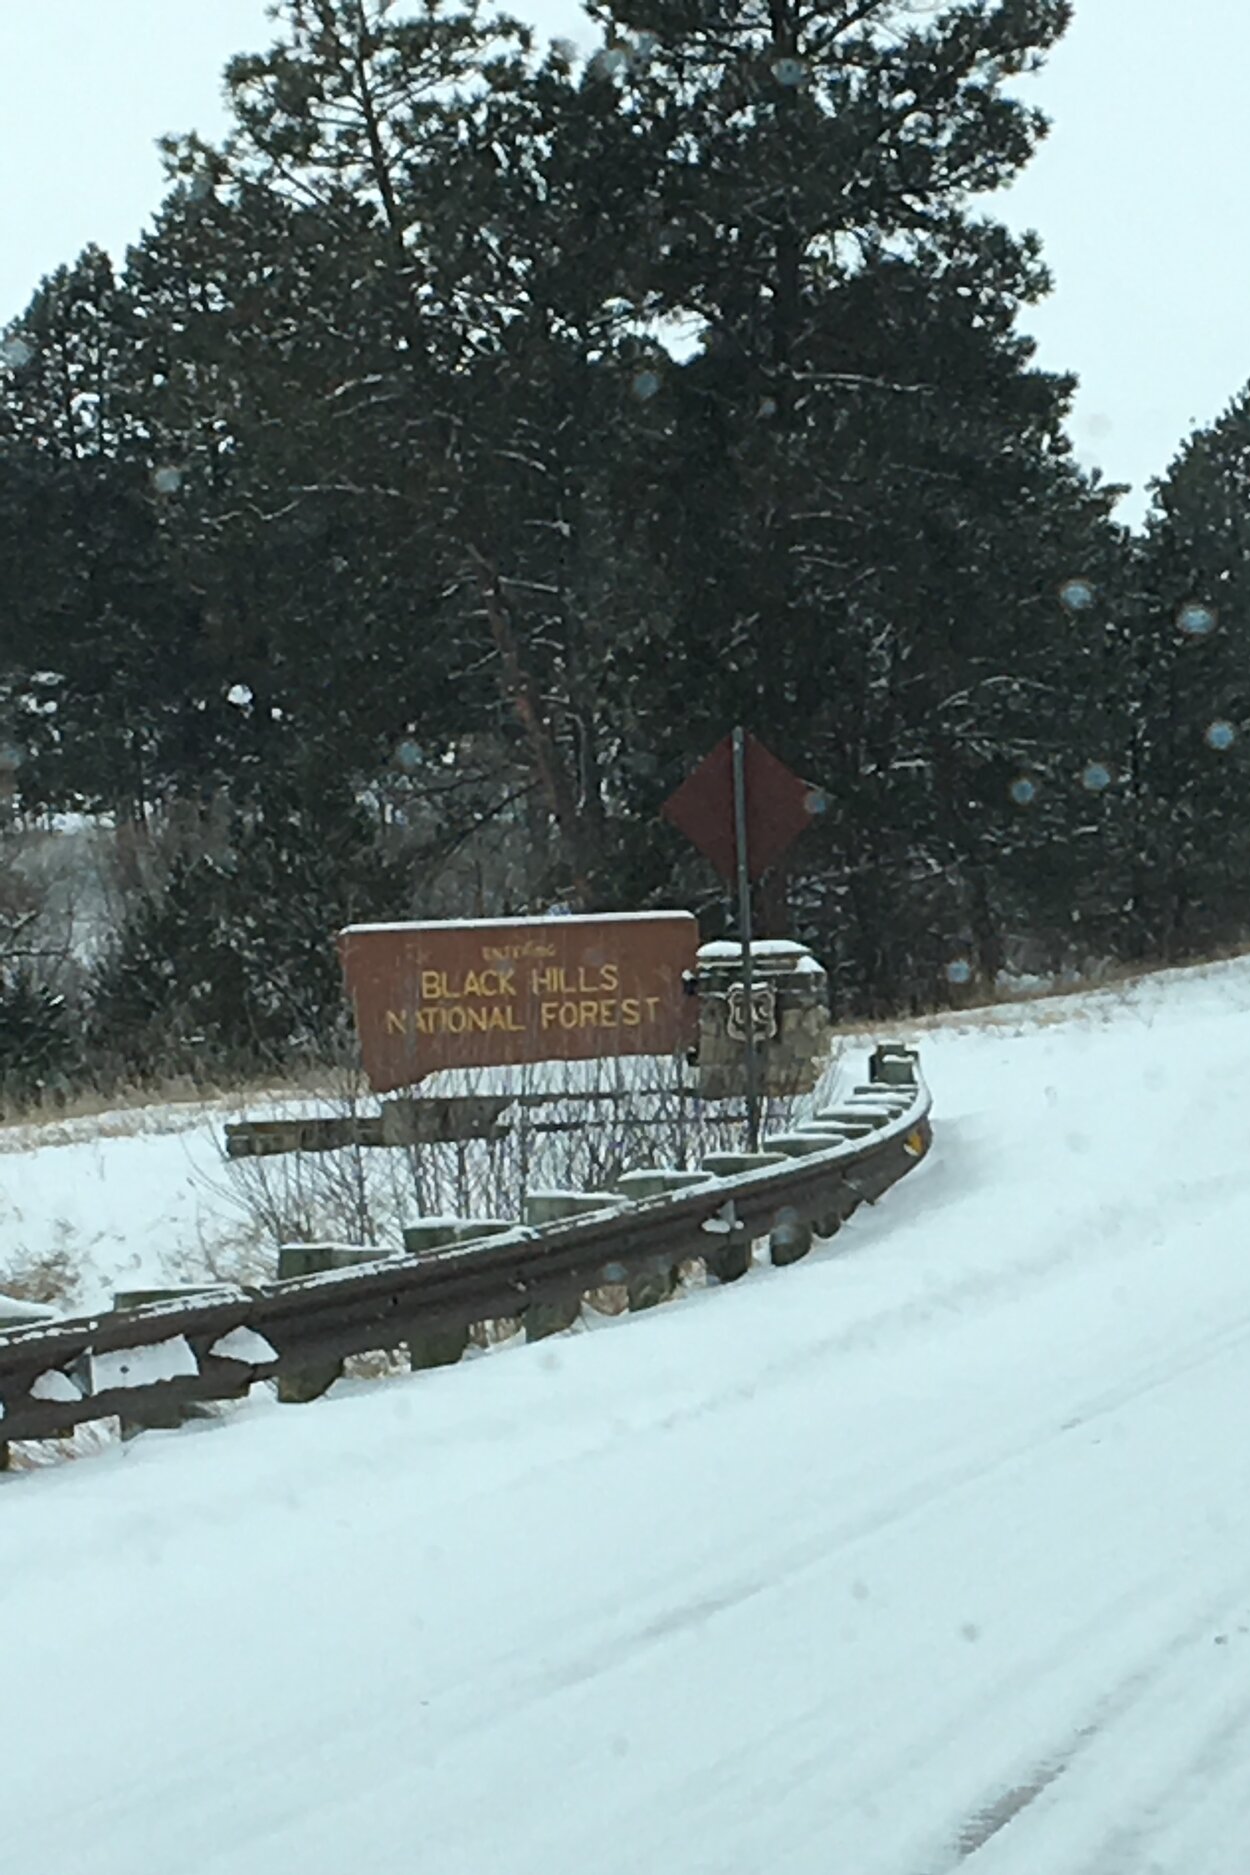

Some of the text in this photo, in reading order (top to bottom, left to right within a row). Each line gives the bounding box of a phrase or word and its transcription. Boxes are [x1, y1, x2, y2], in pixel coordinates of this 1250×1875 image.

[422, 964, 618, 999] BLACK HILLS
[386, 997, 660, 1034] NATIONAL FOREST
